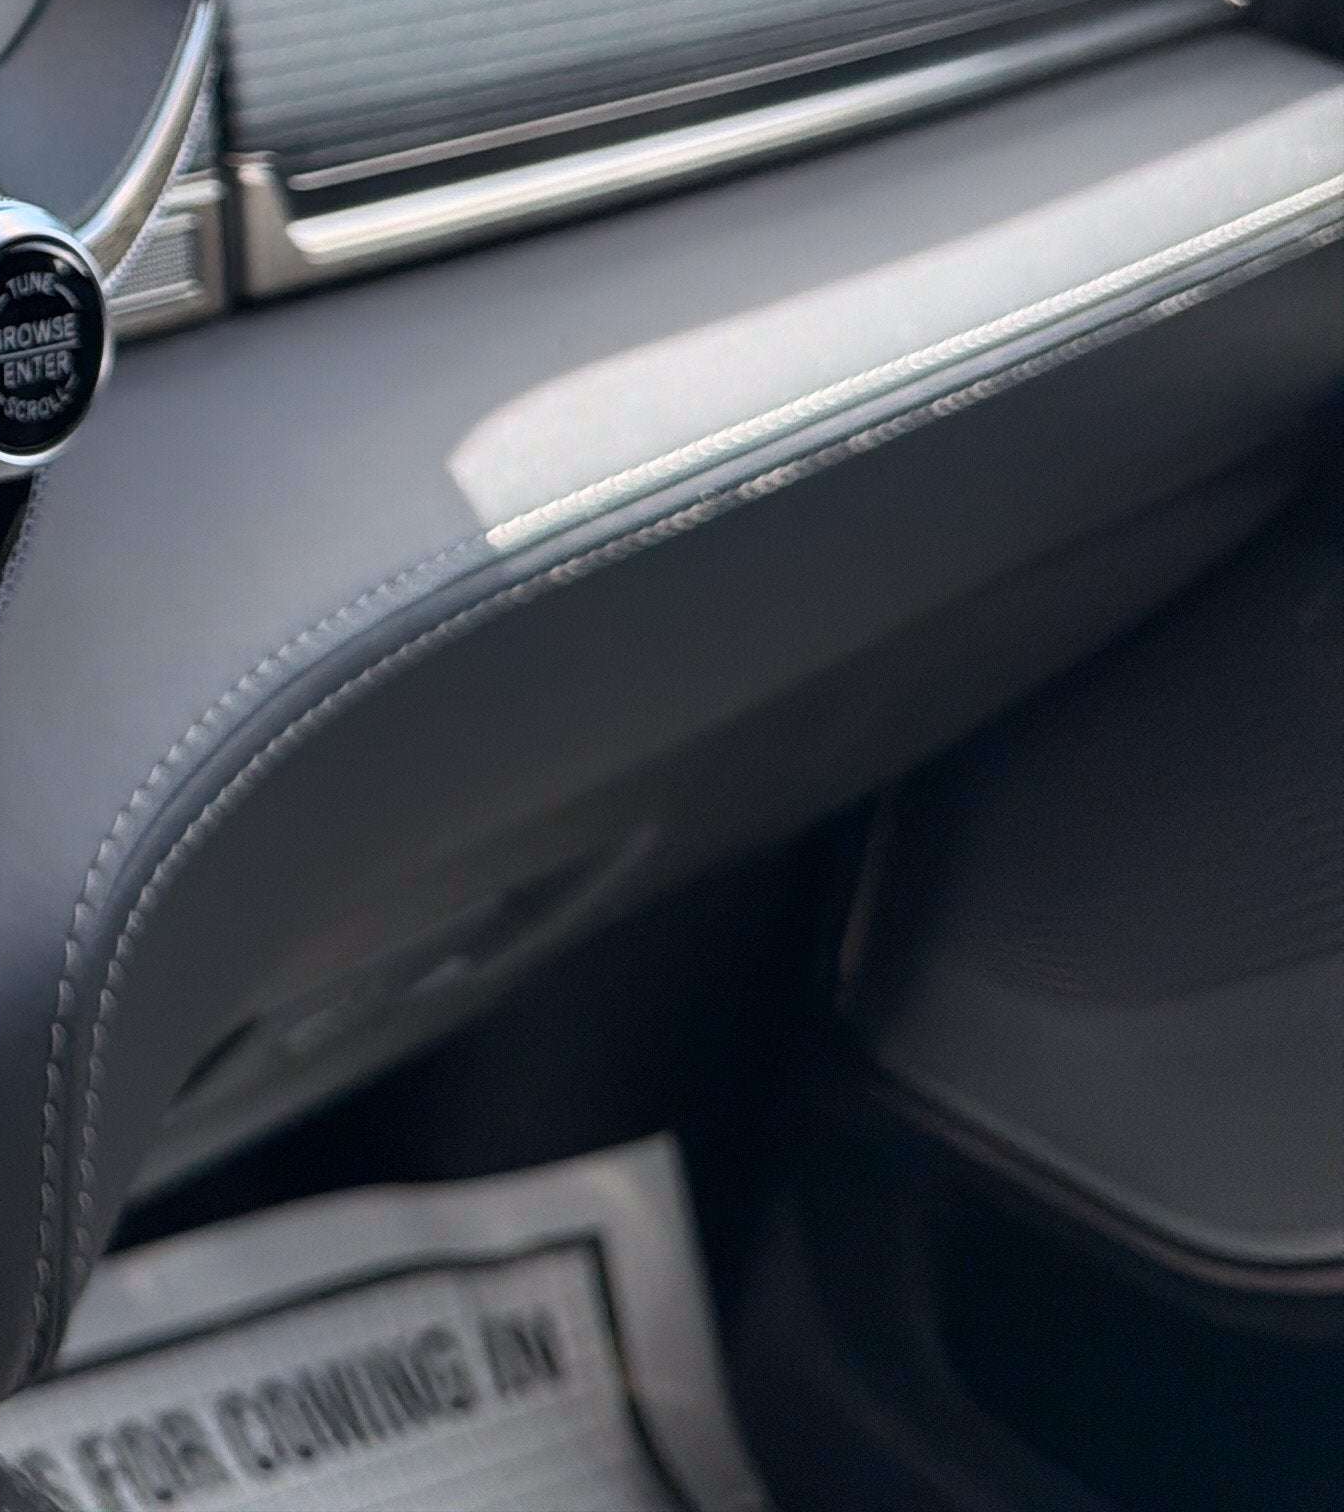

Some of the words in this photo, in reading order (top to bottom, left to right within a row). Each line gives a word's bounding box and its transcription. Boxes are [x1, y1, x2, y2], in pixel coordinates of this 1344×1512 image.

[5, 271, 57, 300] TUNE
[3, 350, 74, 389] ENTER
[3, 385, 72, 423] SCROLL
[213, 1322, 476, 1480] COMING
[477, 1303, 564, 1397] IN
